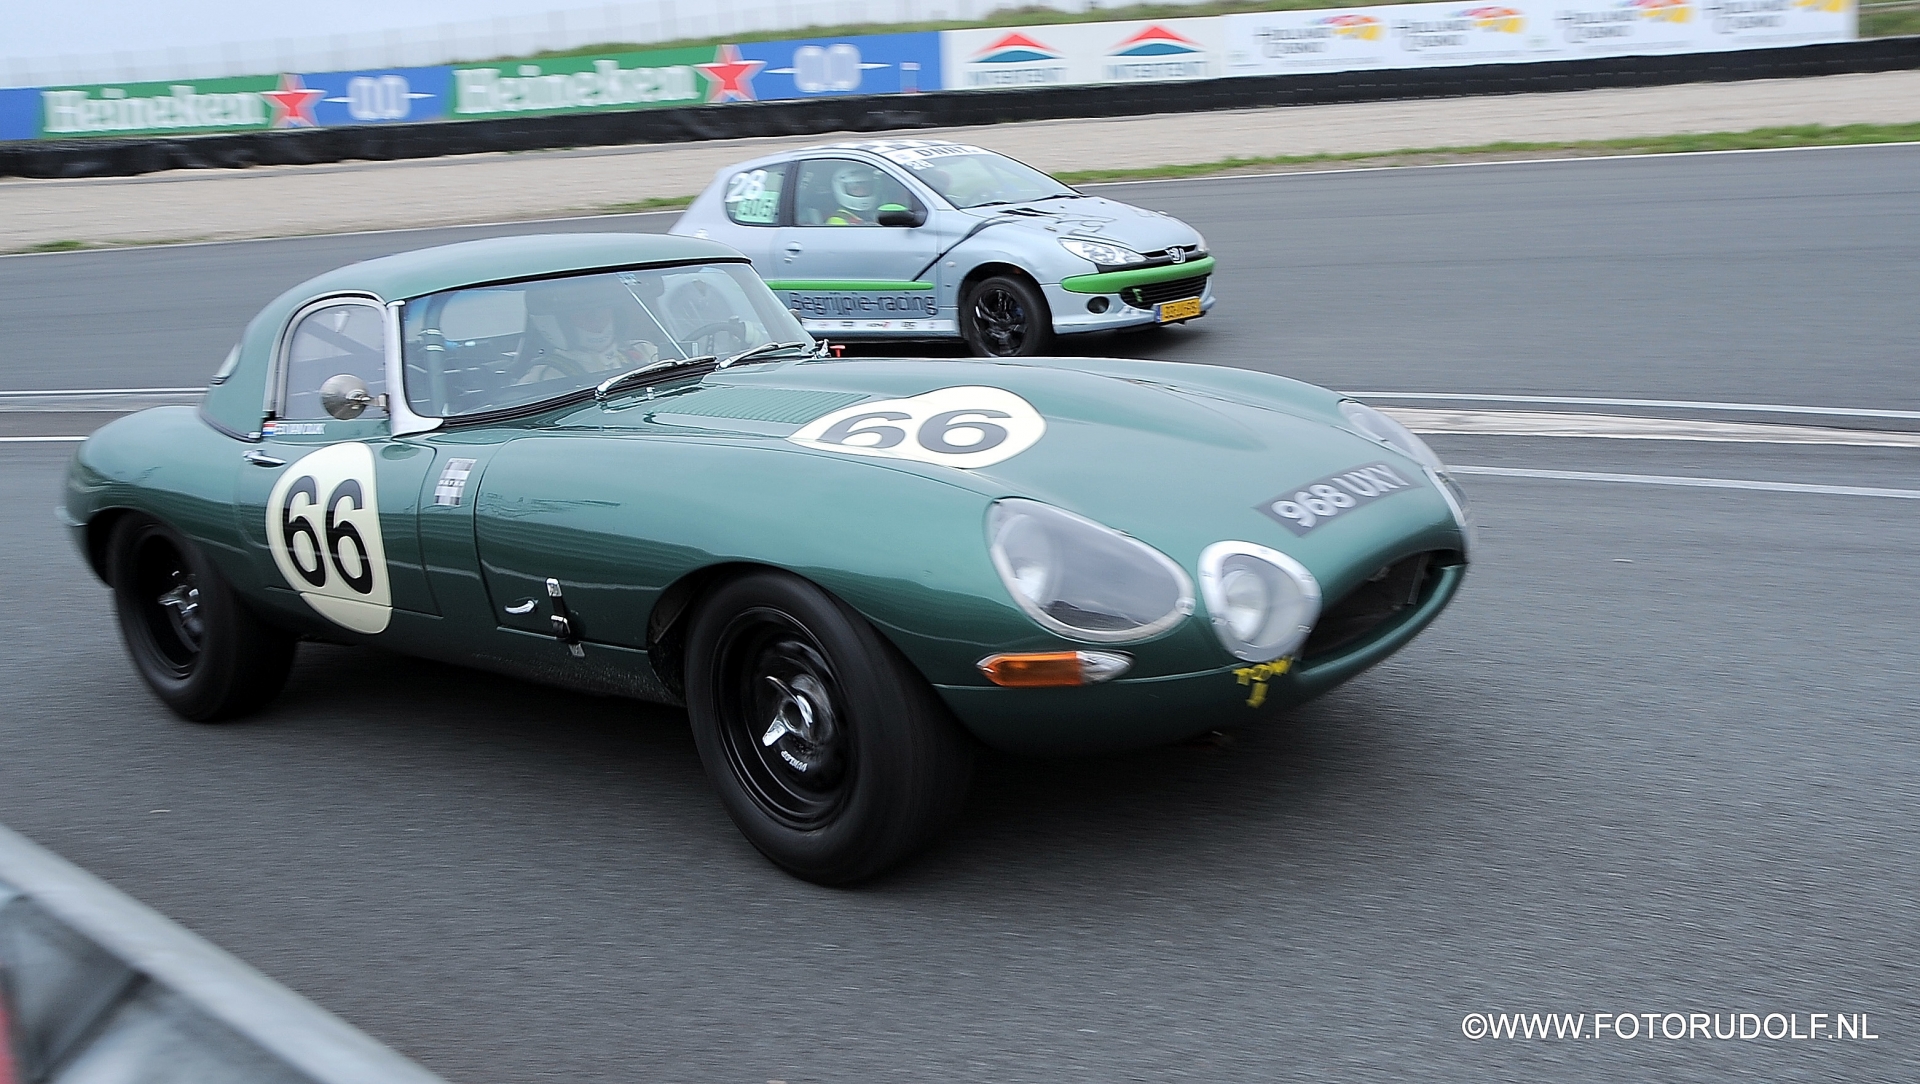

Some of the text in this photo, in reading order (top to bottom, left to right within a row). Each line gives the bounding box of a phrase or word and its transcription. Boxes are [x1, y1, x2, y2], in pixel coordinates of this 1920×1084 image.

[41, 85, 268, 132] Heineken
[452, 60, 701, 113] Heineken
[725, 169, 768, 203] 28
[815, 408, 1013, 455] 66
[1271, 464, 1410, 528] 968 UXY
[282, 475, 373, 594] 66
